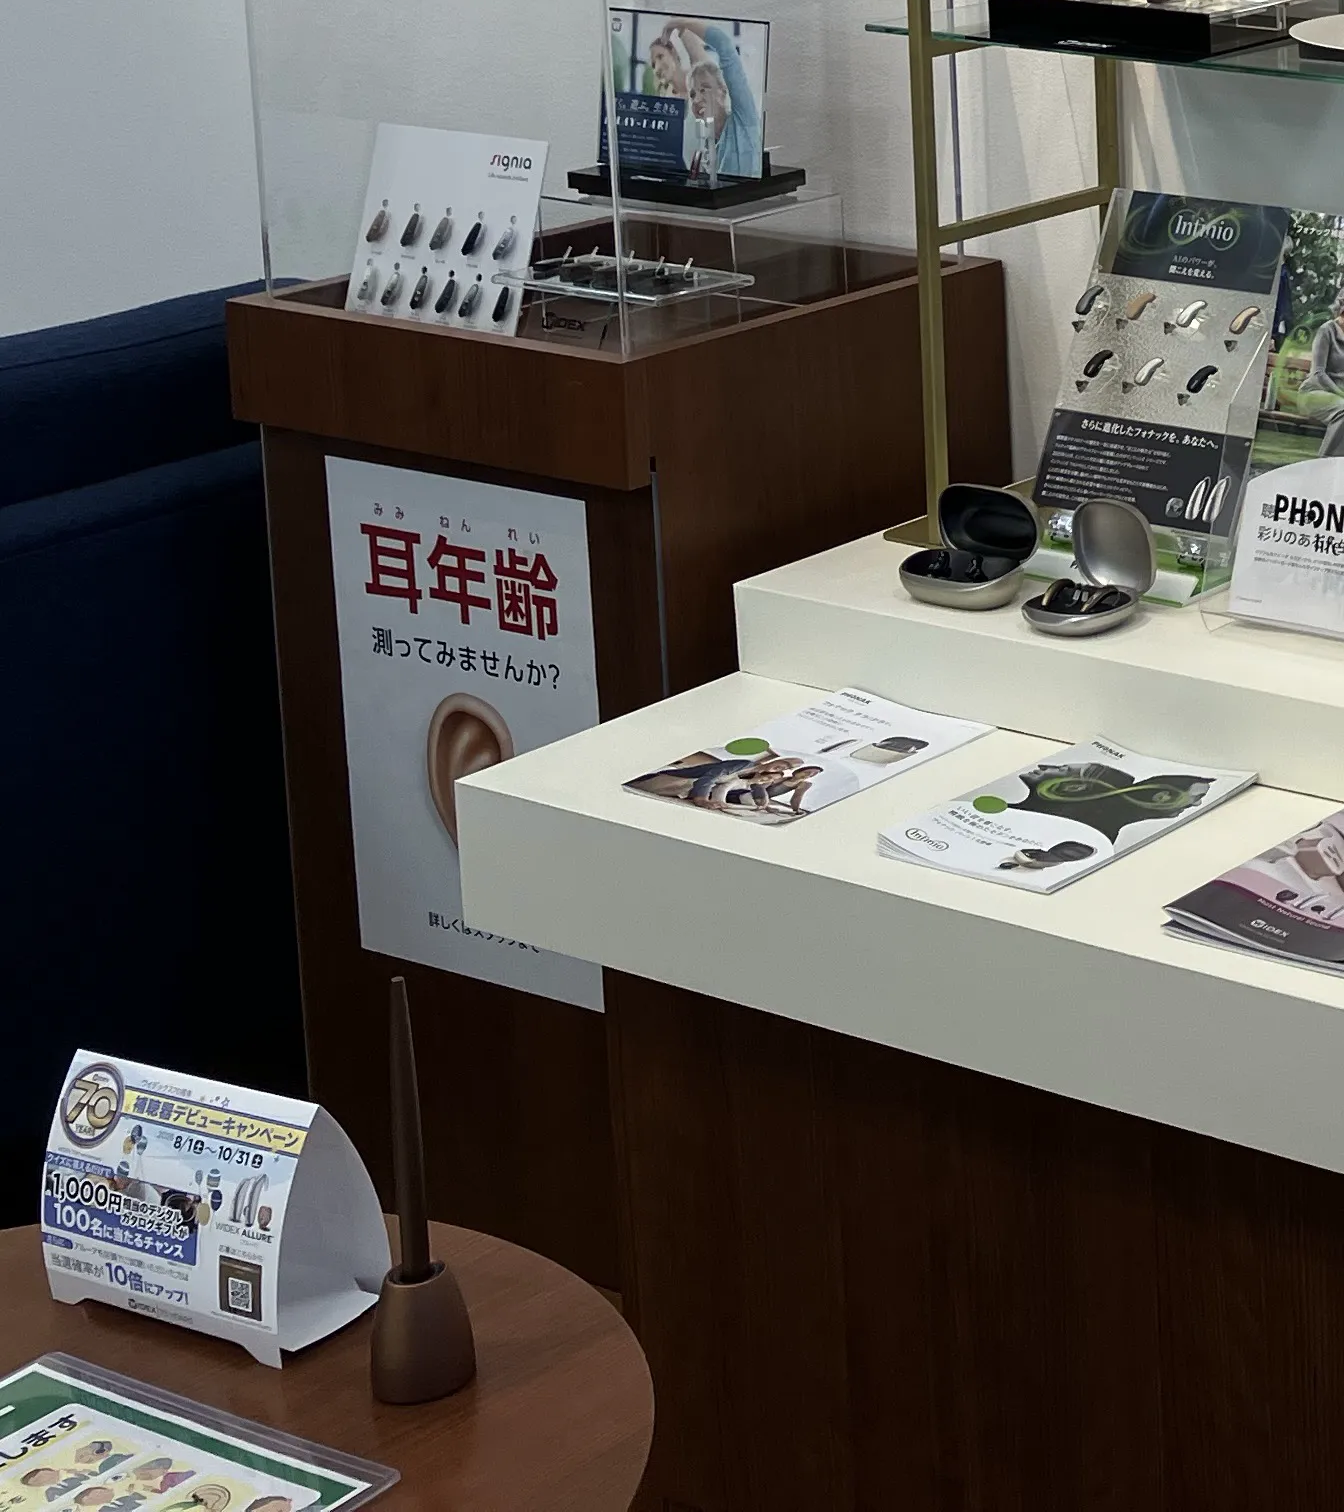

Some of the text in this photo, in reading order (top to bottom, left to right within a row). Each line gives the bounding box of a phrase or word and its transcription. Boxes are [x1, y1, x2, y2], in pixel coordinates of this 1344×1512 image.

[489, 152, 533, 173] signia
[1173, 211, 1235, 245] Infinio
[1080, 418, 1222, 451] さらに進化したフォナックを、あなたへ。
[359, 522, 560, 642] 耳年齢
[370, 625, 562, 691] 測ってみませんか？
[1256, 897, 1276, 910] Most
[1250, 919, 1290, 938] WIDEX
[132, 1094, 301, 1149] 補聴器デビューキャンペーン
[52, 1171, 122, 1214] 1,000円
[53, 1202, 185, 1261] 100名に当たるチャンス
[120, 1212, 190, 1241] カタログギフトが
[51, 1252, 190, 1307] 当選確率が10倍にアップ！
